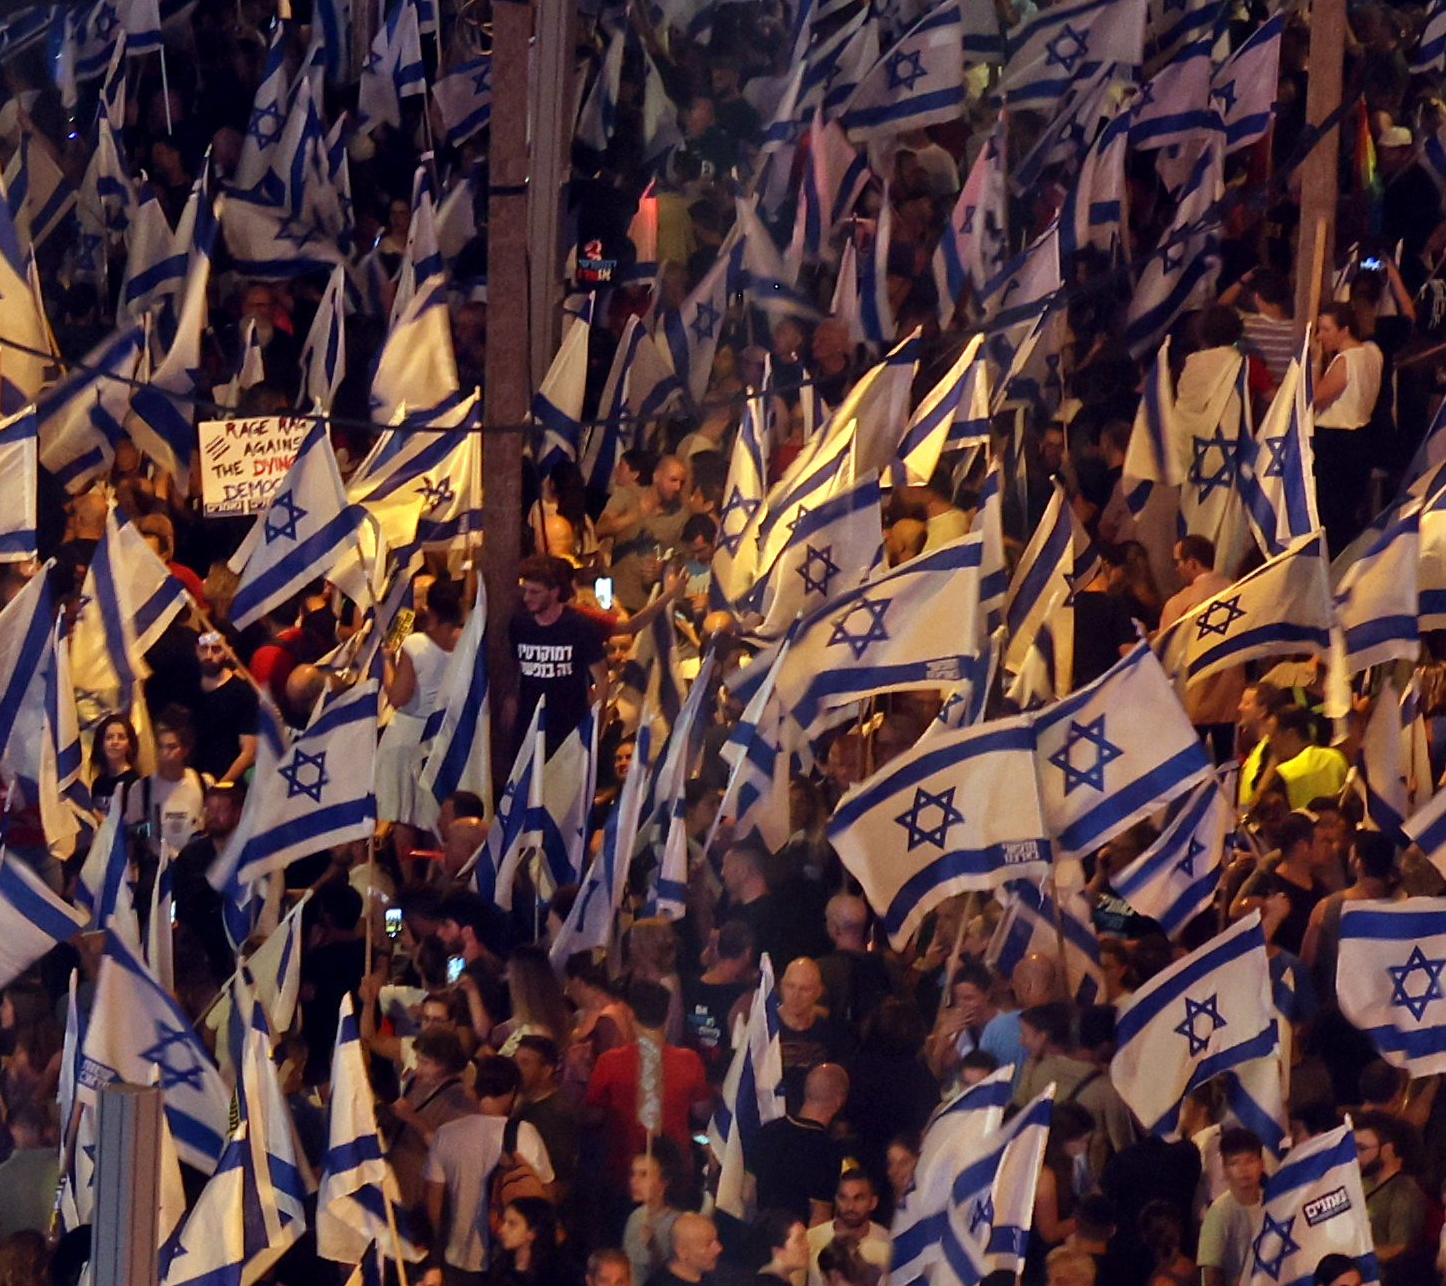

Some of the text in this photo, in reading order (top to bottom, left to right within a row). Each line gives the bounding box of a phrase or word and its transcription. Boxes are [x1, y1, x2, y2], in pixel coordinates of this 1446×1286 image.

[226, 417, 307, 439] RAGE RAG
[243, 437, 303, 457] AGAINS
[211, 461, 243, 481] THE
[223, 477, 284, 502] DEMOC
[520, 661, 574, 679] זה בנפש
